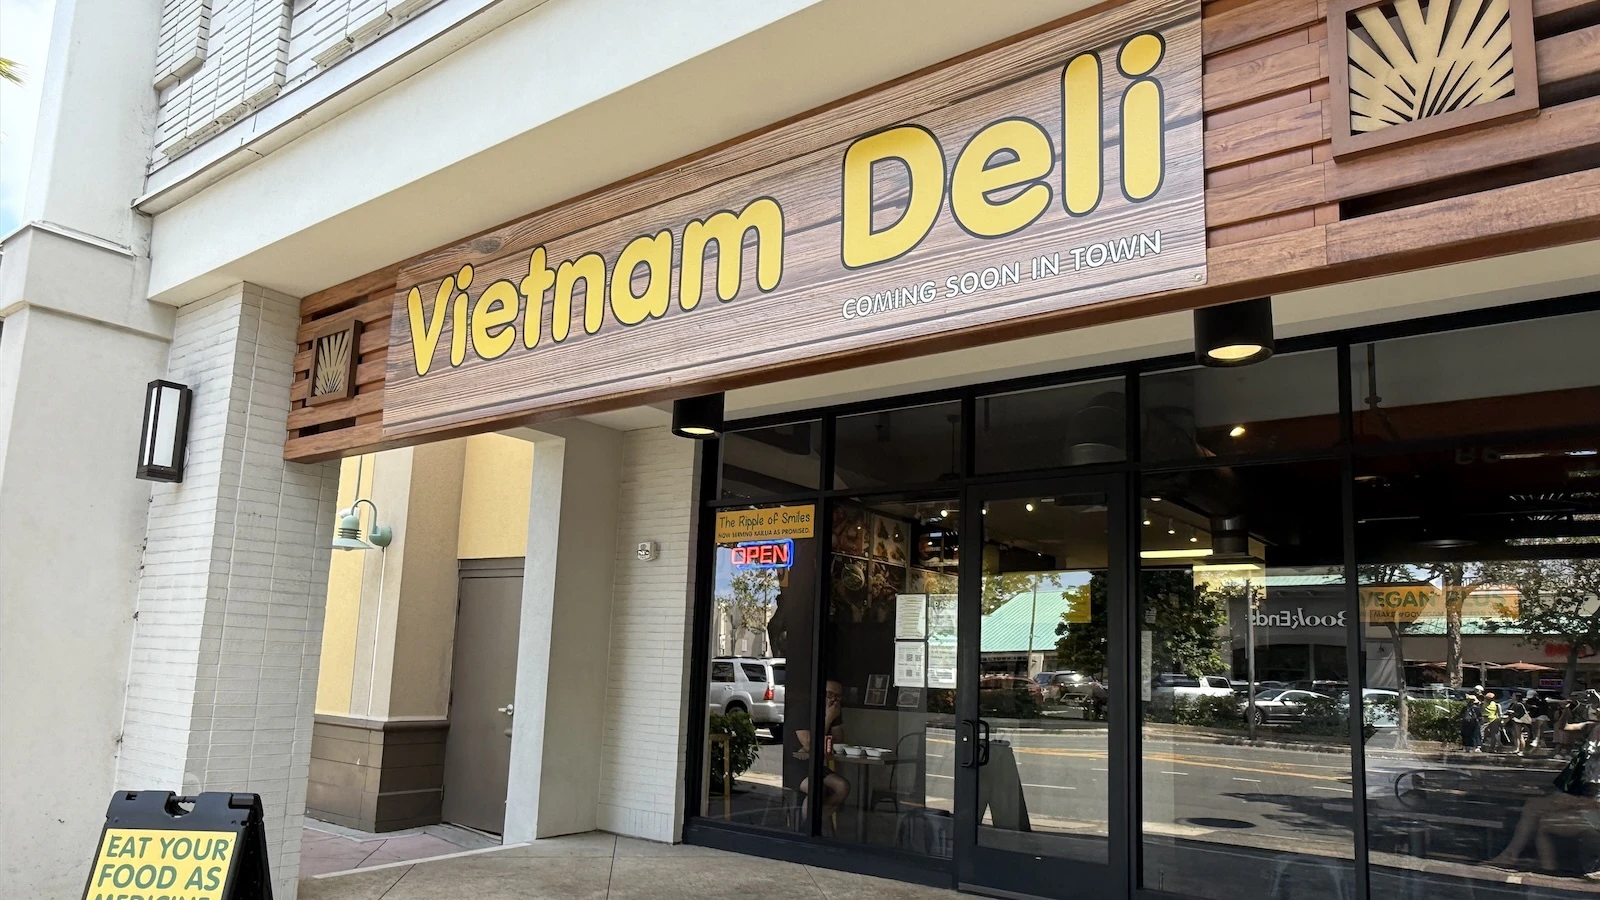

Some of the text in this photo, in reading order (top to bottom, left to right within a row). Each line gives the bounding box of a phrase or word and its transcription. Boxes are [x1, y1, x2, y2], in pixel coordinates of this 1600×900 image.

[407, 30, 1166, 376] Vietnam Deli
[842, 229, 1162, 320] COMING SOON IN TOWN
[719, 510, 811, 530] The Ripple of Smiles
[731, 543, 789, 565] OPEN
[1361, 590, 1435, 609] VEGAN
[106, 835, 230, 861] EAT YOUR
[97, 863, 222, 891] FOOD AS
